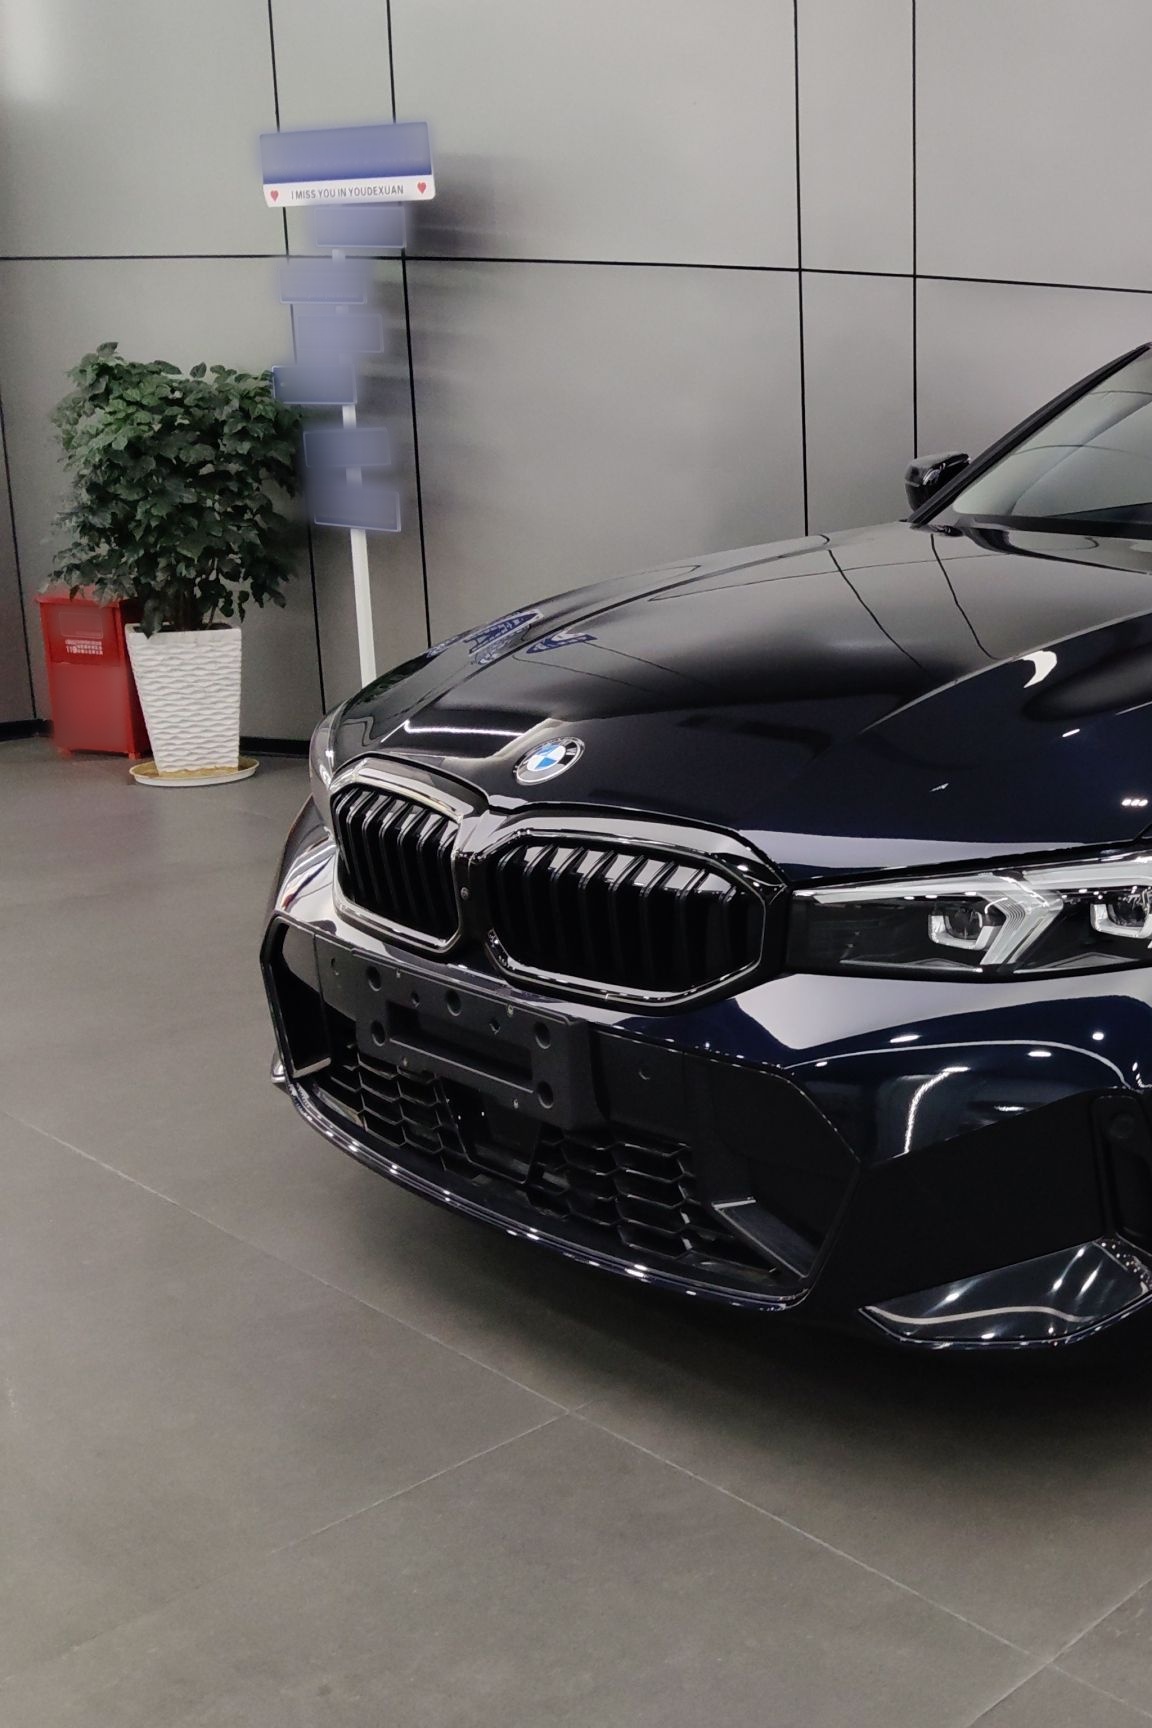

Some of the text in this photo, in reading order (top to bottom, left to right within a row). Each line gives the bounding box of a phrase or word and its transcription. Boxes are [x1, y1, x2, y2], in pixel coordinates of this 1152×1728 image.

[295, 189, 316, 200] MISS
[318, 188, 336, 198] YOU
[337, 187, 347, 197] IN
[349, 185, 404, 197] YOUDEXUAN
